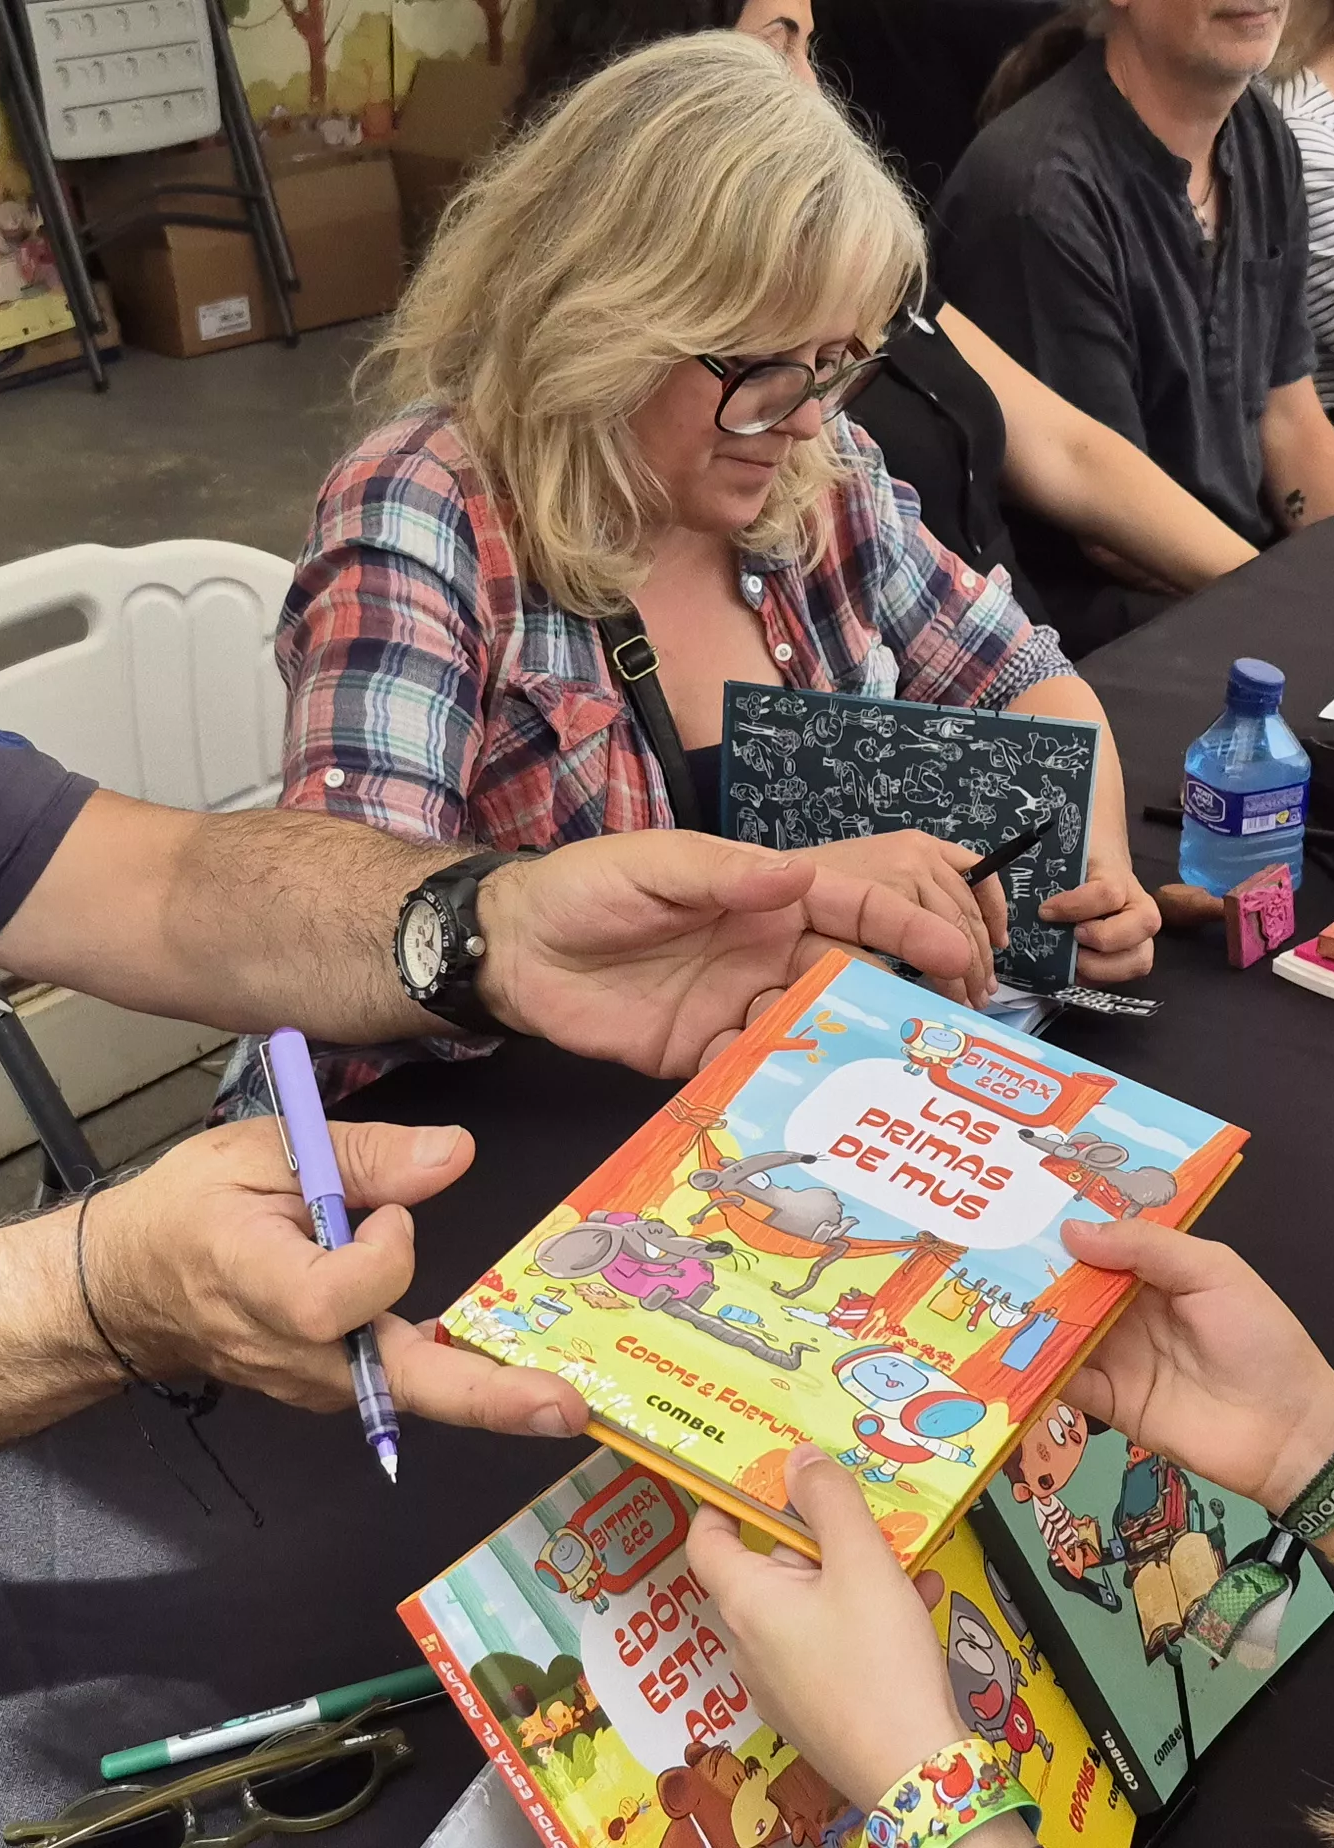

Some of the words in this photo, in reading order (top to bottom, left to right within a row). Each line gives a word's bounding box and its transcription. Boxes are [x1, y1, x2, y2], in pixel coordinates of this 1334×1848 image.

[962, 1050, 1057, 1102] BITMAX
[974, 1075, 1021, 1101] &CO
[919, 1096, 1001, 1146] LAS
[855, 1107, 1015, 1191] PRIMAS
[827, 1133, 891, 1173] DE
[888, 1160, 990, 1221] MUS
[697, 1381, 717, 1399] &
[588, 1484, 661, 1552] BITMAX
[620, 1518, 655, 1556] &CO
[437, 1659, 484, 1720] AGUA?
[637, 1613, 728, 1715] ESTÁ
[481, 1720, 501, 1748] EL
